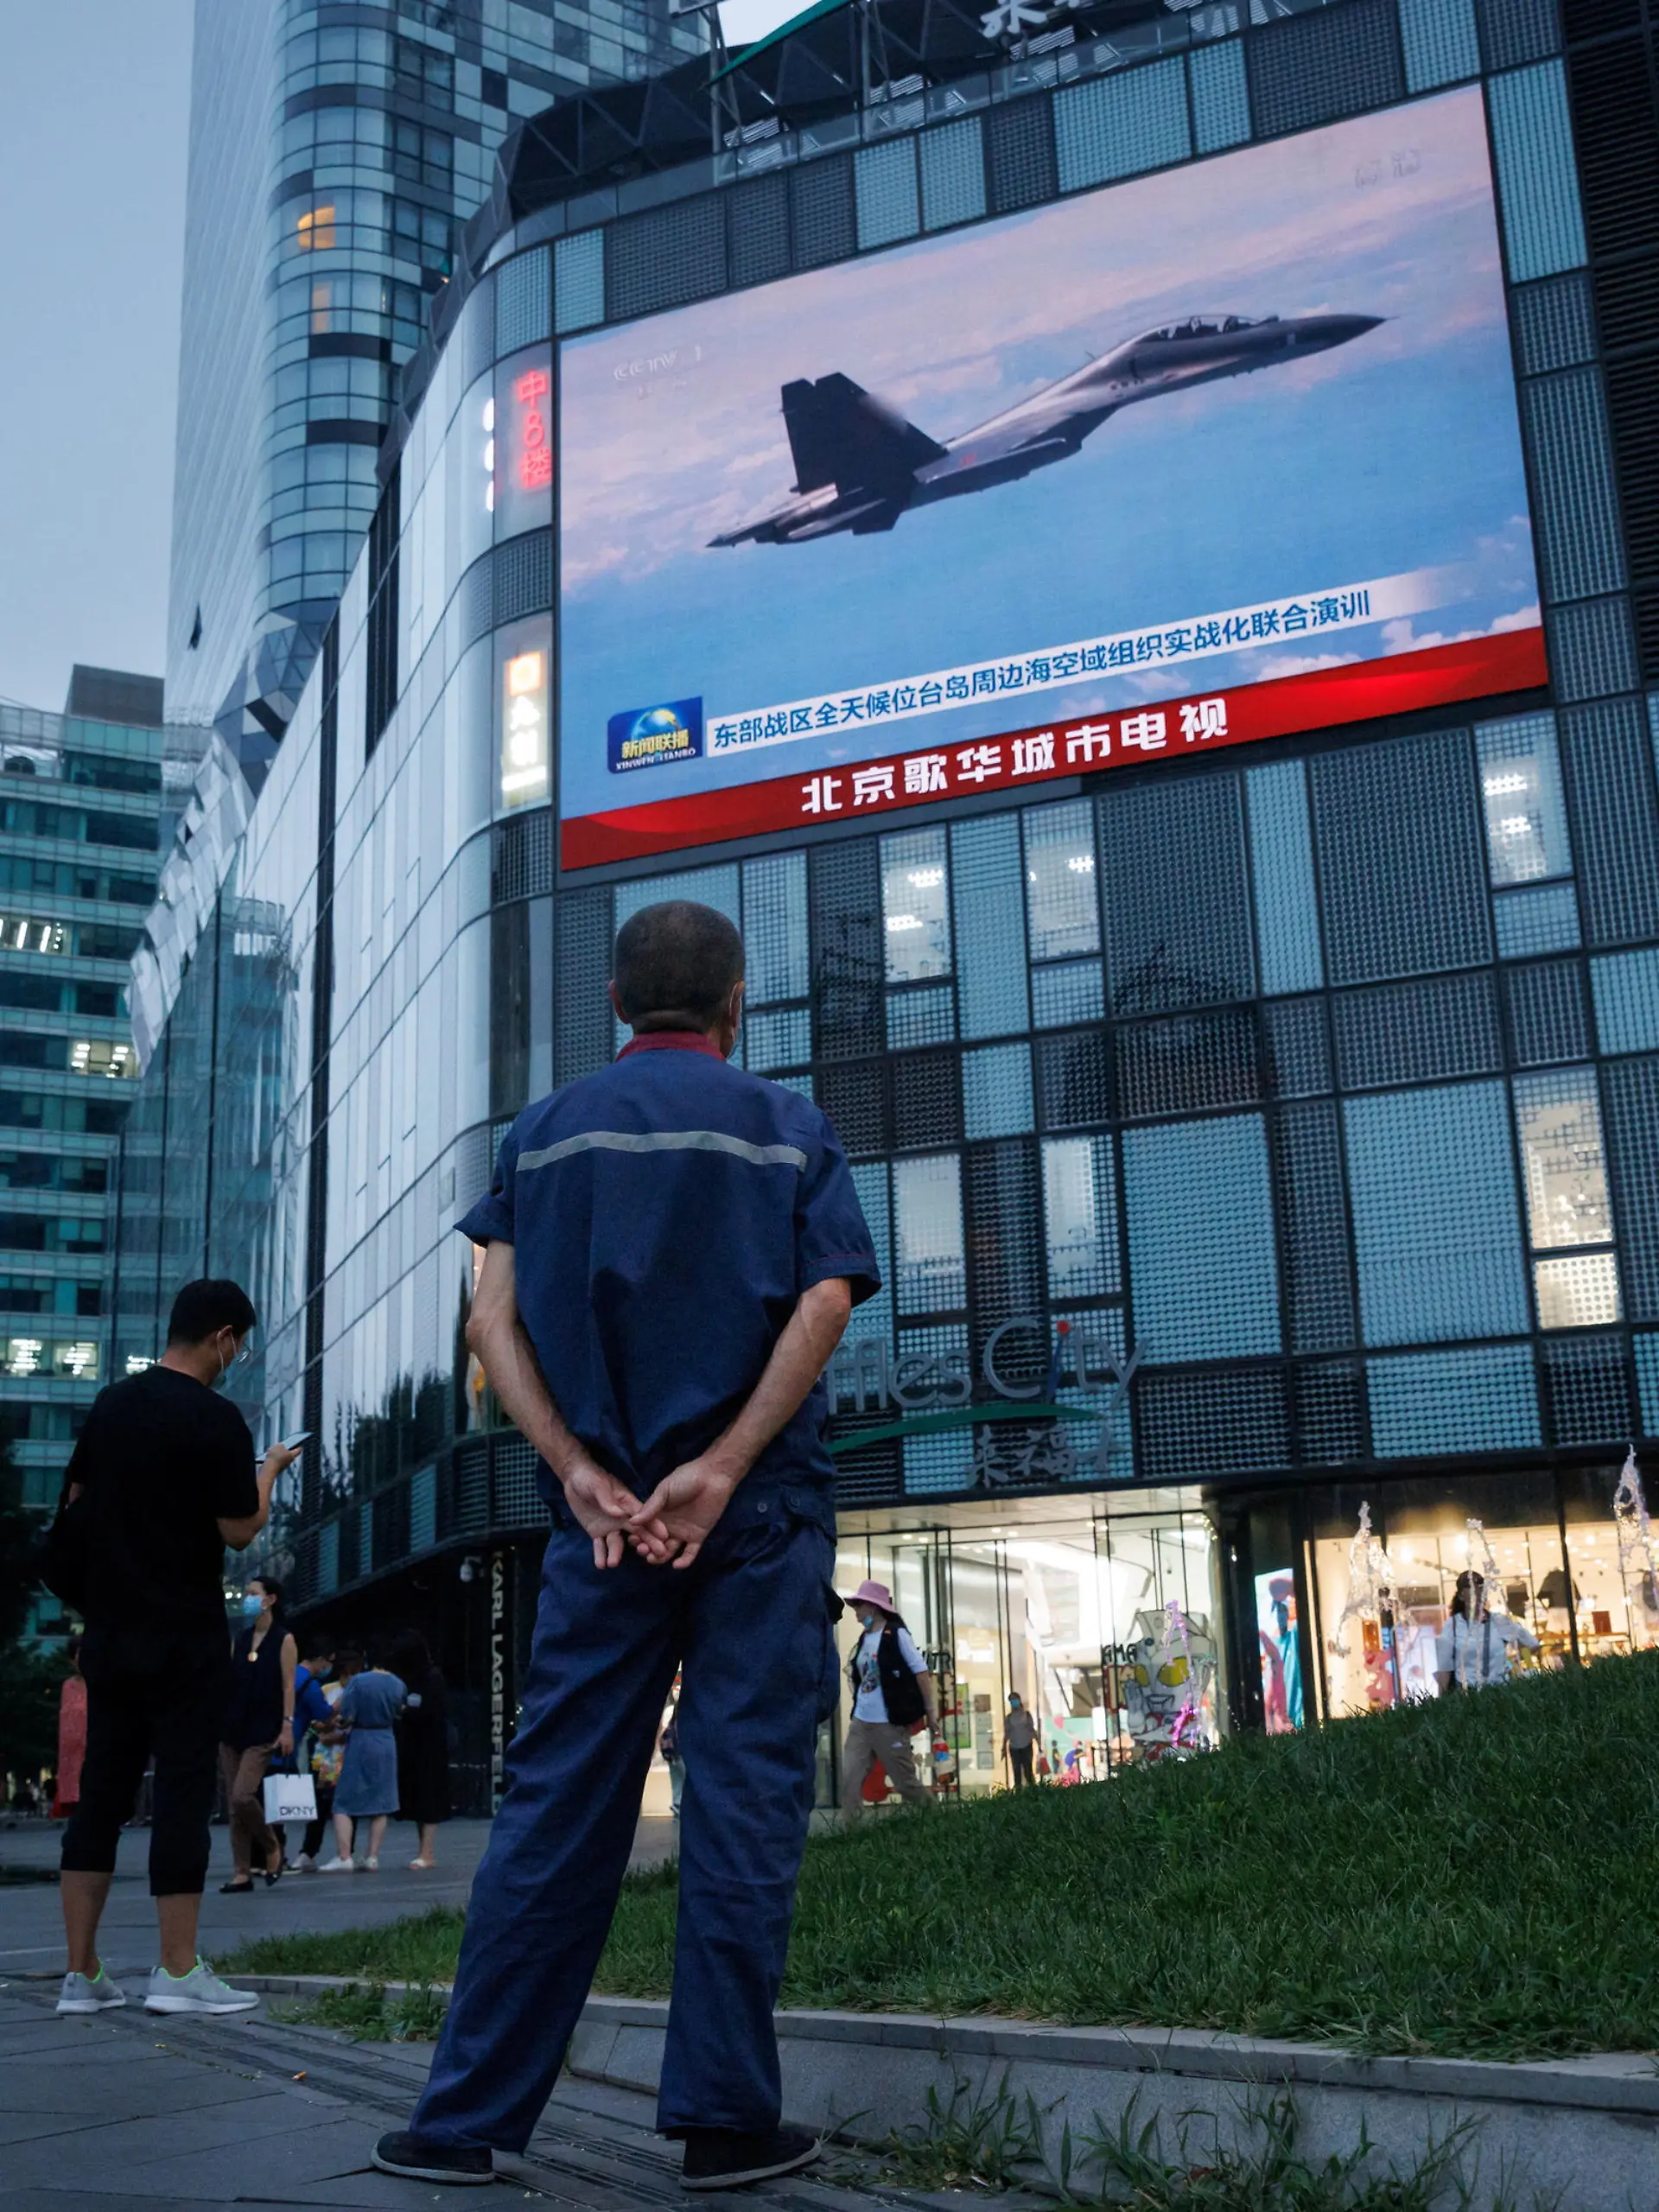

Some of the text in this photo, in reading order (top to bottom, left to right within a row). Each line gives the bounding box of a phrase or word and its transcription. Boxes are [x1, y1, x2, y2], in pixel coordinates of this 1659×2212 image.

[517, 369, 551, 489] 中8楼
[715, 589, 1370, 747] 东部战区全天候位台岛周边海空域组织实战化联合演训
[621, 729, 689, 759] 新闻联播
[801, 698, 1229, 813] 北京歌华城市电视
[827, 1315, 1147, 1415] ffles City
[492, 1551, 503, 1630] KARL
[279, 1805, 315, 1816] DKNY
